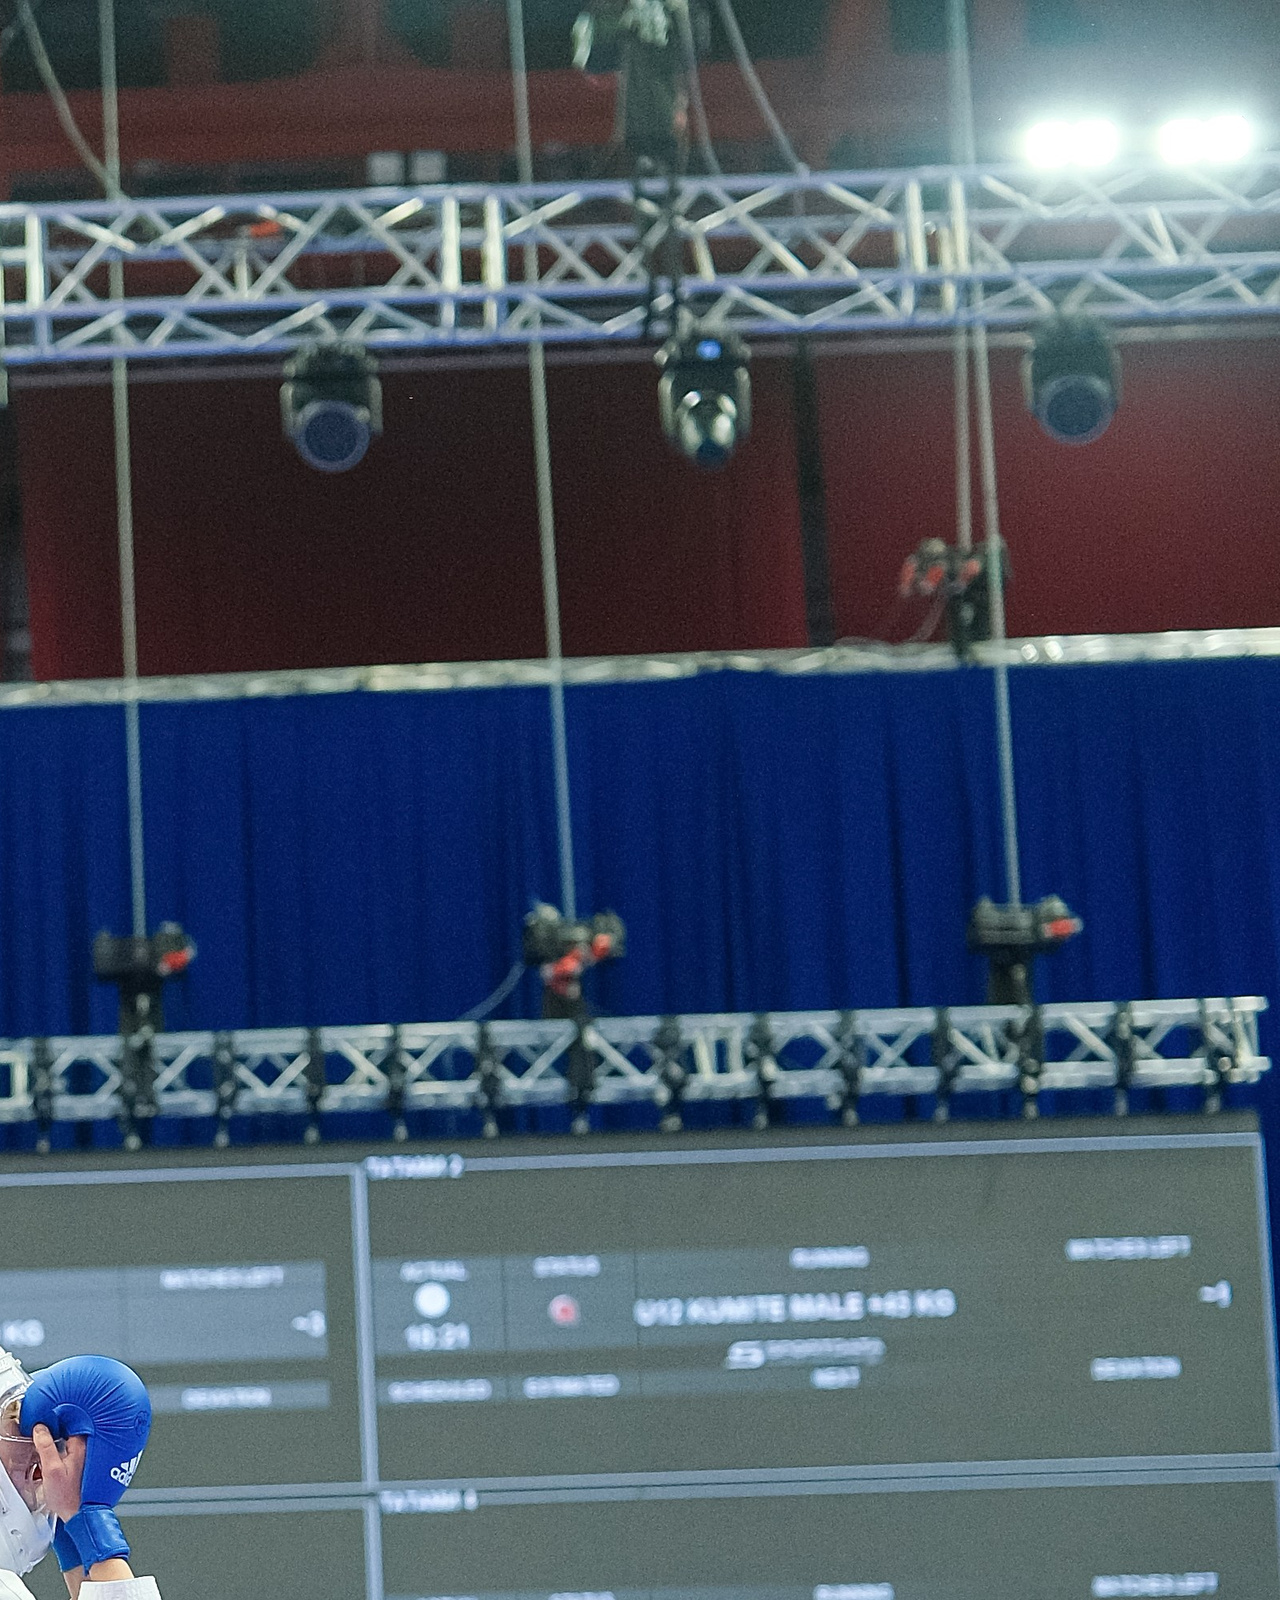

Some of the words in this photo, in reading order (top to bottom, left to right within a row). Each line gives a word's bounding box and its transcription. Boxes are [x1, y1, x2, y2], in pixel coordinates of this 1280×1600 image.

[634, 1298, 683, 1326] U12
[686, 1294, 786, 1324] KUMITE
[788, 1290, 865, 1322] MALE
[914, 1288, 957, 1317] KG
